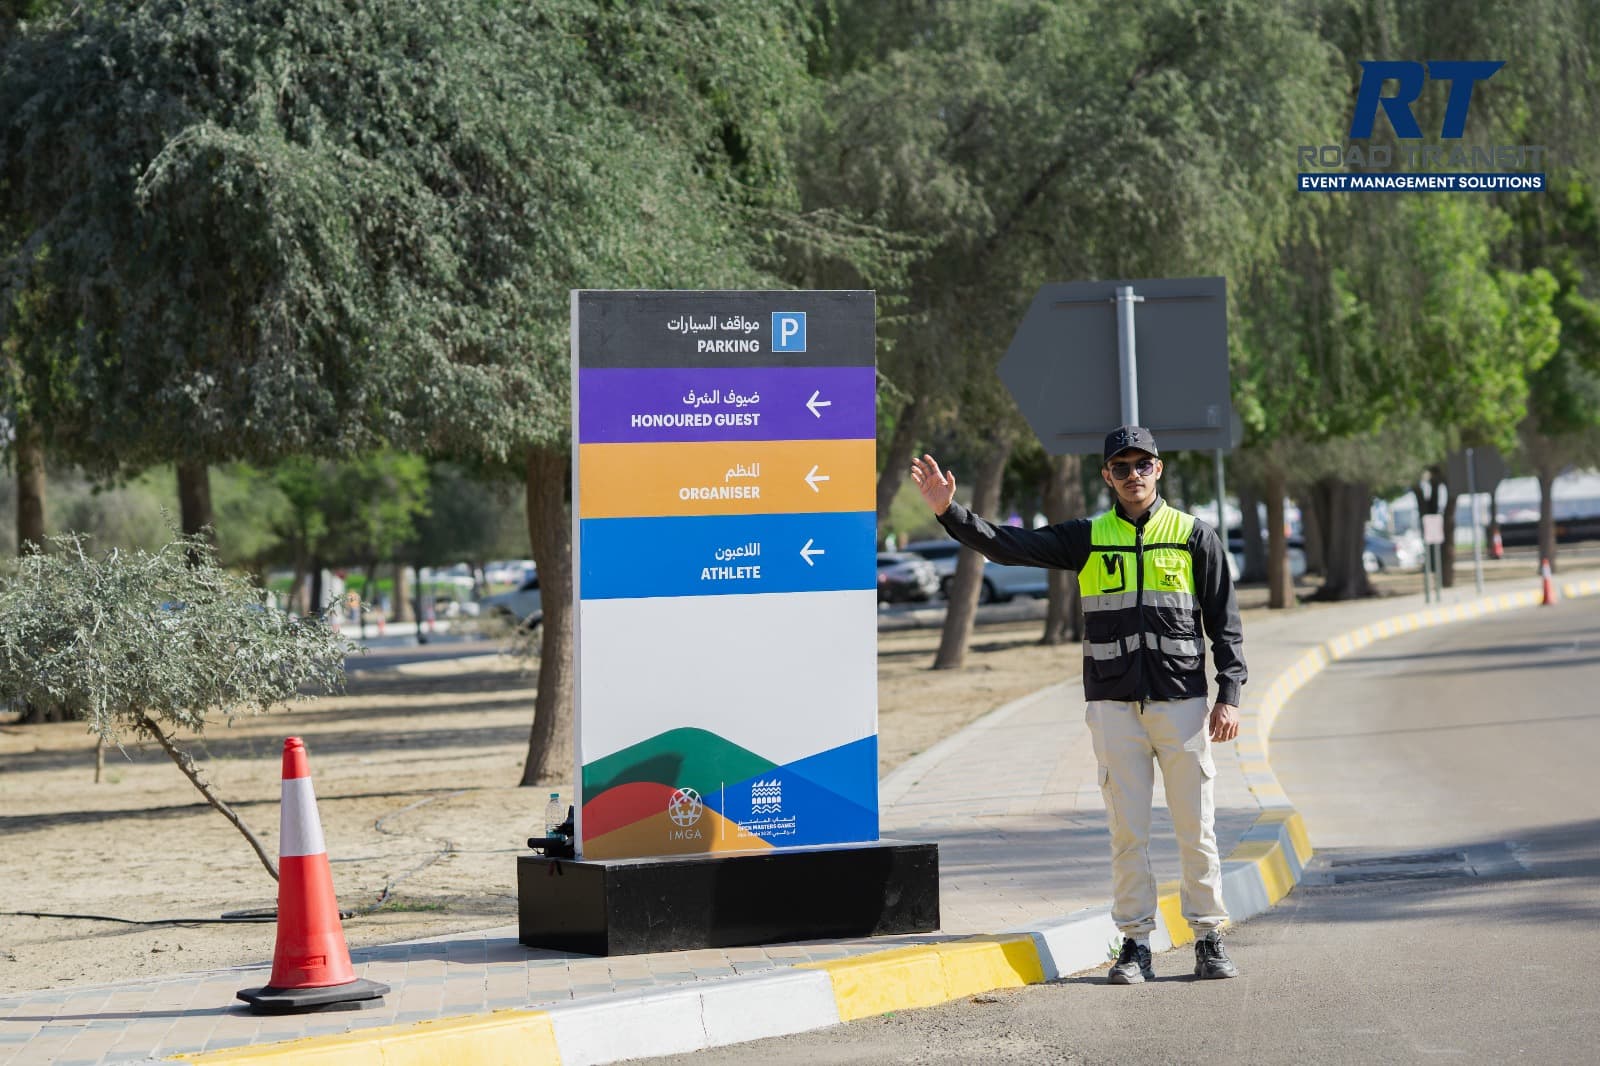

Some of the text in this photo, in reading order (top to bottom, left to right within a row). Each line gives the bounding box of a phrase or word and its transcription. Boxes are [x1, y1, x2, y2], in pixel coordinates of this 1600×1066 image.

[667, 315, 760, 334] مواقف السيارات
[781, 318, 799, 347] P
[697, 339, 760, 353] PARKING
[682, 389, 760, 408] ضيوف الشرف
[631, 413, 761, 428] HONOURED GUEST
[725, 462, 760, 483] المنظم
[679, 486, 761, 500] ORGANISER
[714, 542, 761, 561] اللاعبون
[700, 565, 761, 580] ATHLETE
[669, 829, 702, 841] IMGA
